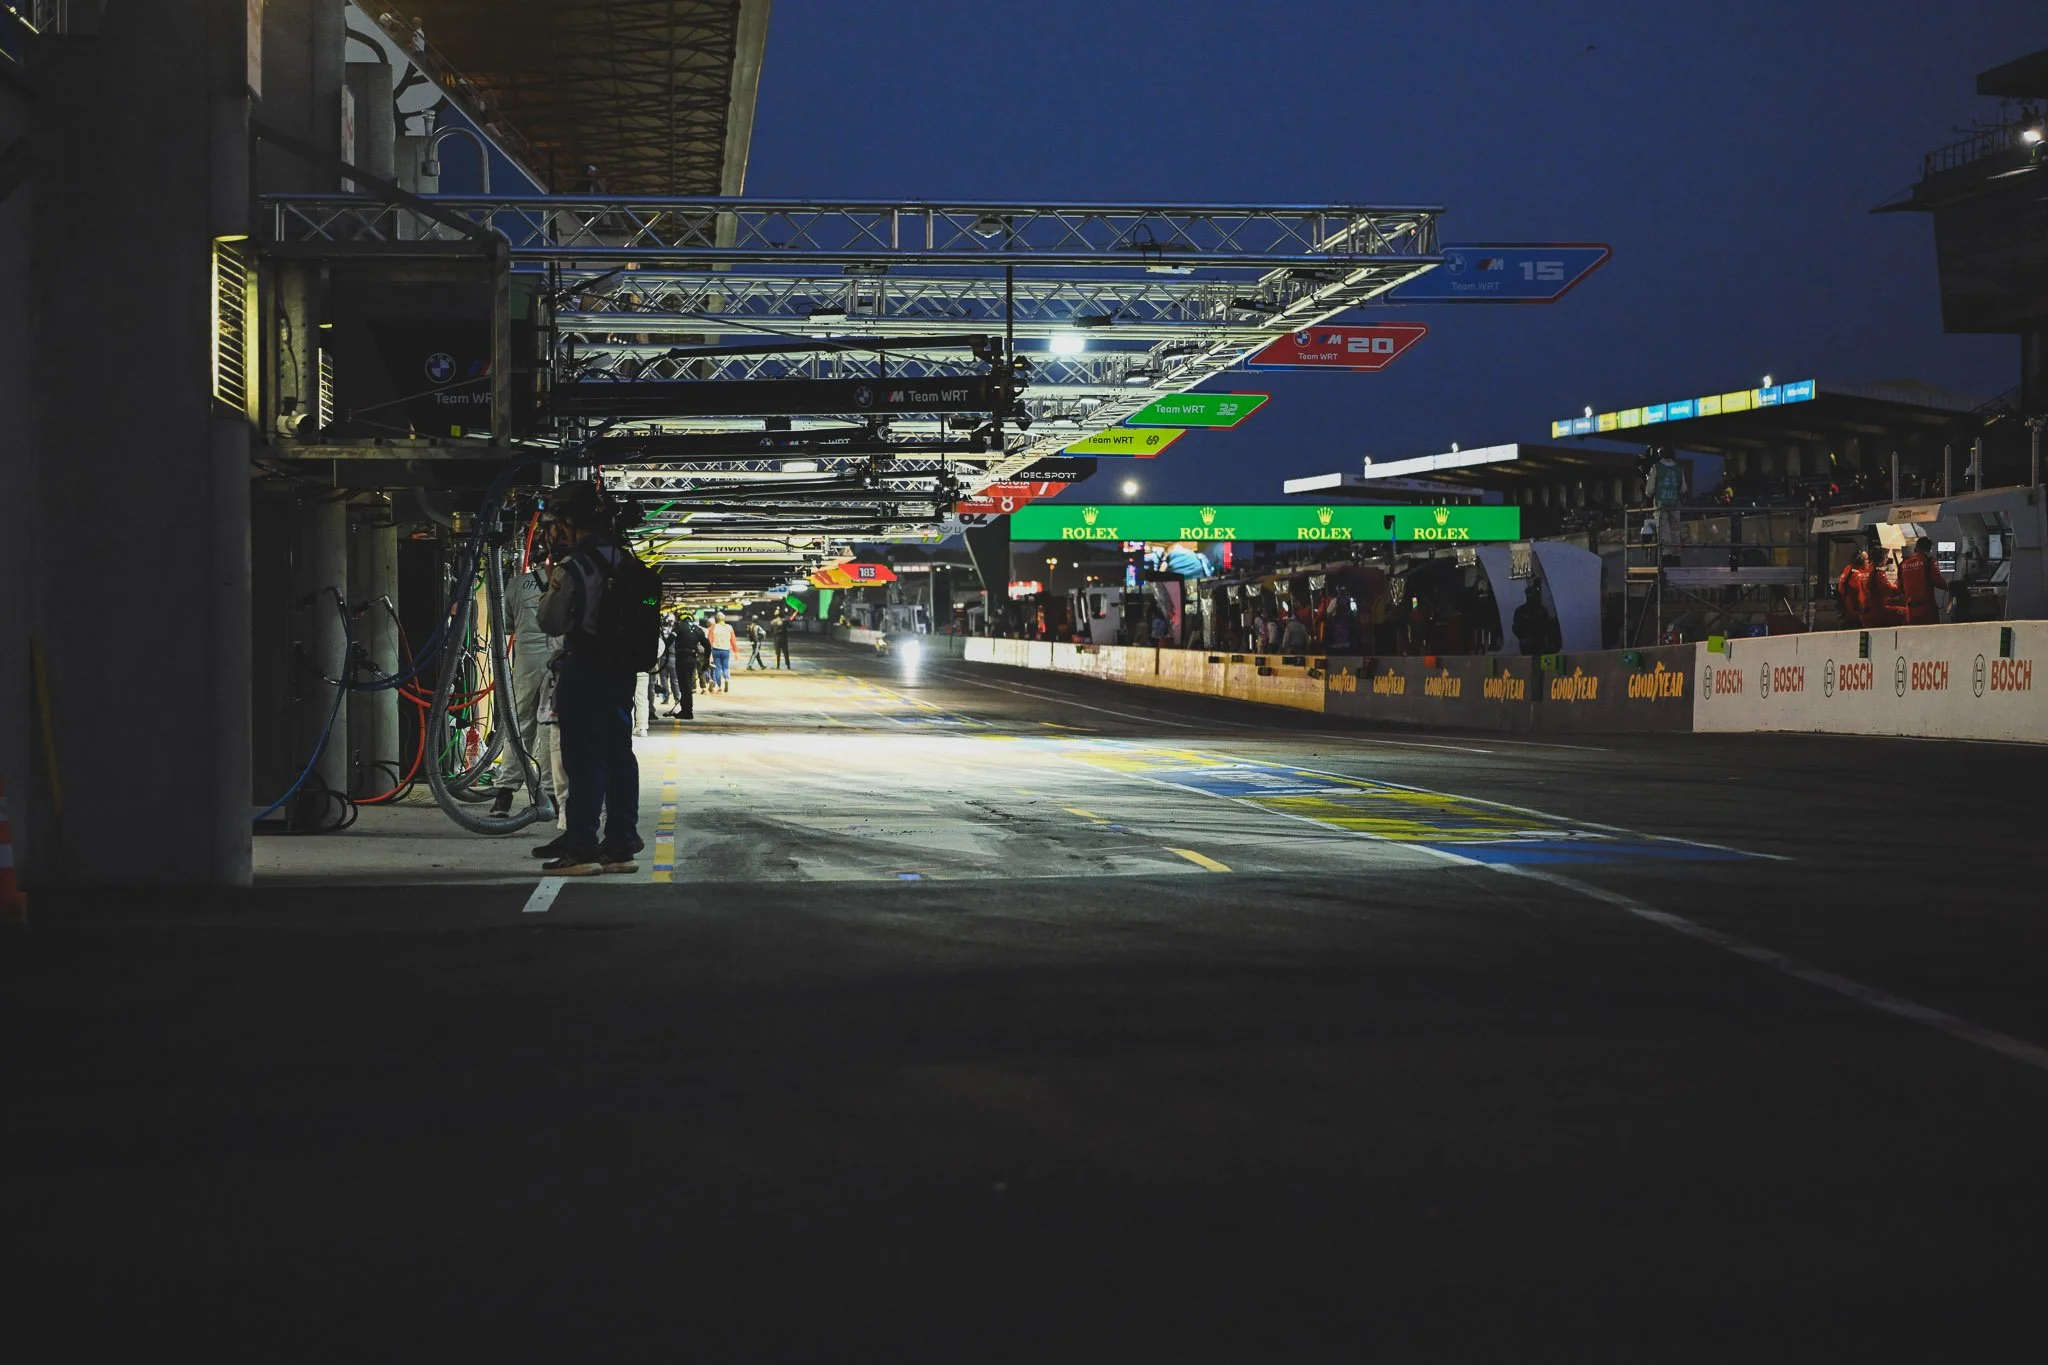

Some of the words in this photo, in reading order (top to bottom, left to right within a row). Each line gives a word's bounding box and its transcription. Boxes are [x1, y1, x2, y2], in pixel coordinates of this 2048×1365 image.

[1520, 261, 1564, 281] 15
[1451, 282, 1476, 291] Team
[1478, 282, 1501, 291] WRT
[1347, 337, 1394, 354] 20
[1298, 352, 1319, 360] Team
[1320, 353, 1339, 361] WRT
[434, 392, 469, 404] Team
[472, 392, 493, 404] WR
[908, 390, 939, 402] Team
[941, 389, 969, 402] WRT
[1155, 404, 1180, 414] Team
[1182, 405, 1206, 414] WRT
[1216, 403, 1239, 416] 32
[1088, 436, 1111, 444] Team
[1113, 436, 1135, 444] WRT
[1146, 435, 1160, 446] 69
[1001, 496, 1014, 512] 8
[1062, 527, 1119, 539] ROLEX
[1180, 527, 1237, 539] ROLEX
[1297, 527, 1352, 540] ROLEX
[1414, 527, 1470, 539] ROLEX
[859, 567, 875, 577] 183
[1715, 669, 1743, 693] BOSCH
[1773, 666, 1805, 692] BOSCH
[1839, 663, 1874, 691] BOSCH
[1911, 661, 1948, 691] BOSCH
[1990, 659, 2033, 691] BOSCH
[1424, 674, 1461, 697] GOODYEAR
[1483, 675, 1525, 701] GOODYEAR
[1551, 673, 1598, 701] GOODYEAR
[1628, 669, 1684, 700] GOODYEAR
